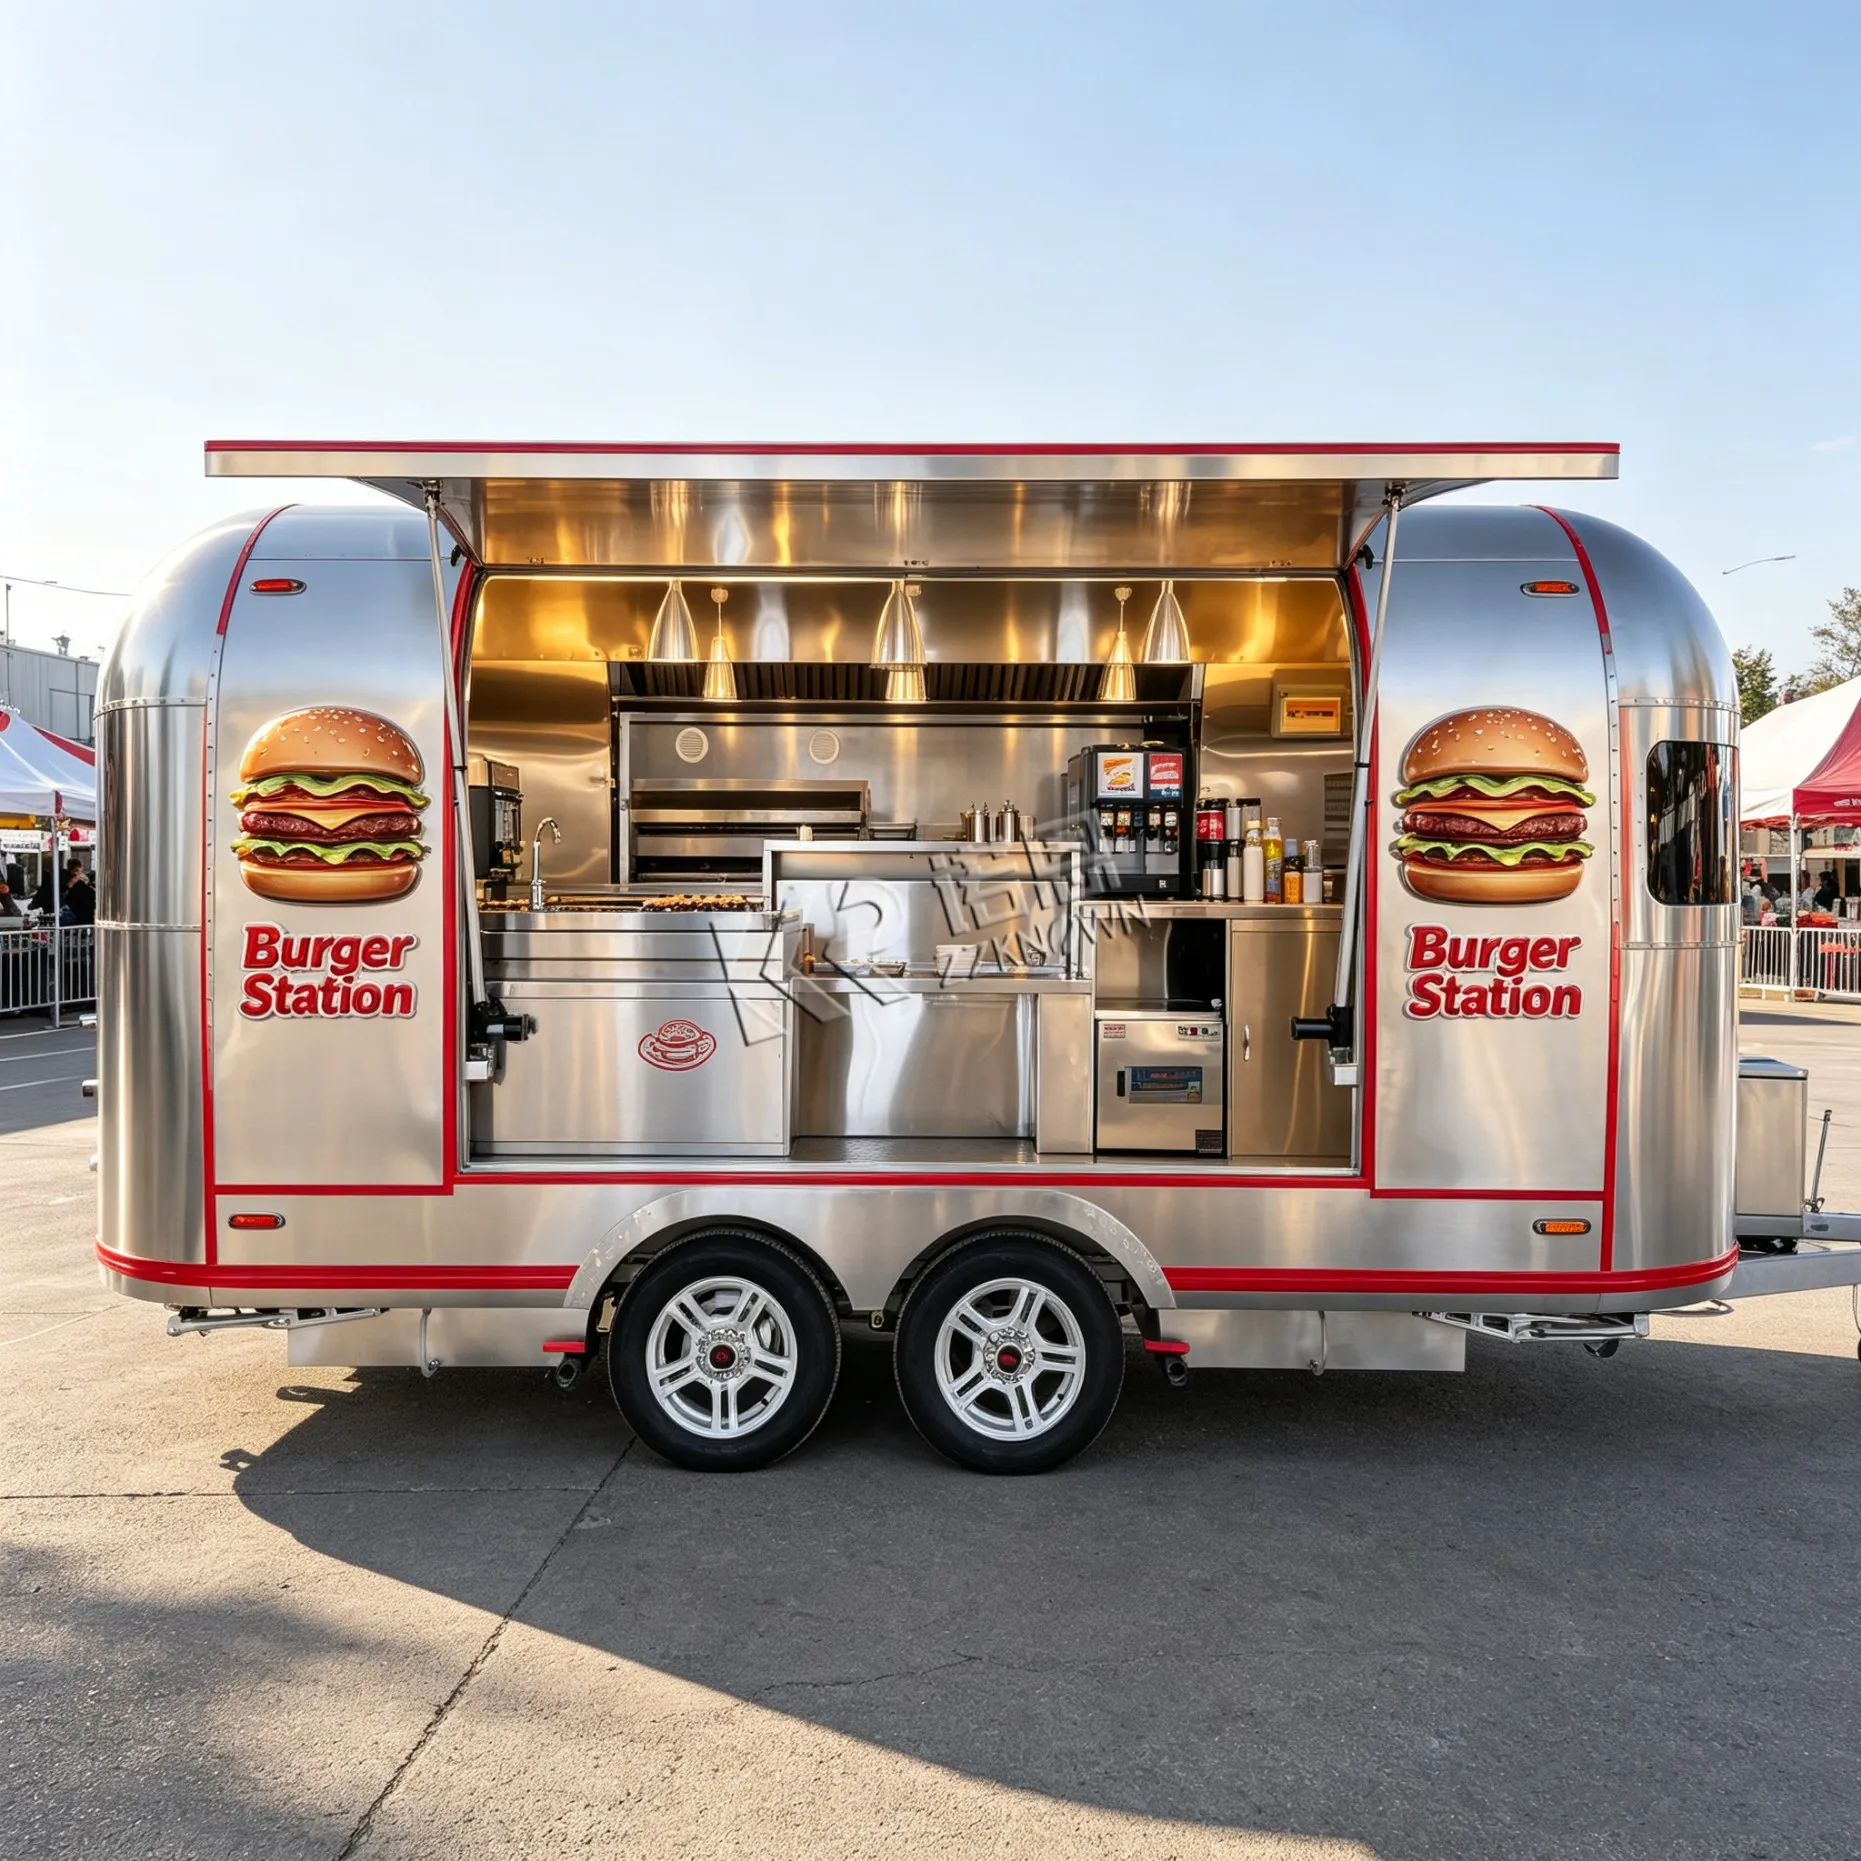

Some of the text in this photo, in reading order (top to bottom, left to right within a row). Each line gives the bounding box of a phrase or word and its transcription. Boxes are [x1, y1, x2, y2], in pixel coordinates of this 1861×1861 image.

[242, 924, 416, 976] Burger
[1408, 924, 1583, 978] Burger
[239, 972, 414, 1017] Station
[1407, 972, 1583, 1017] Station
